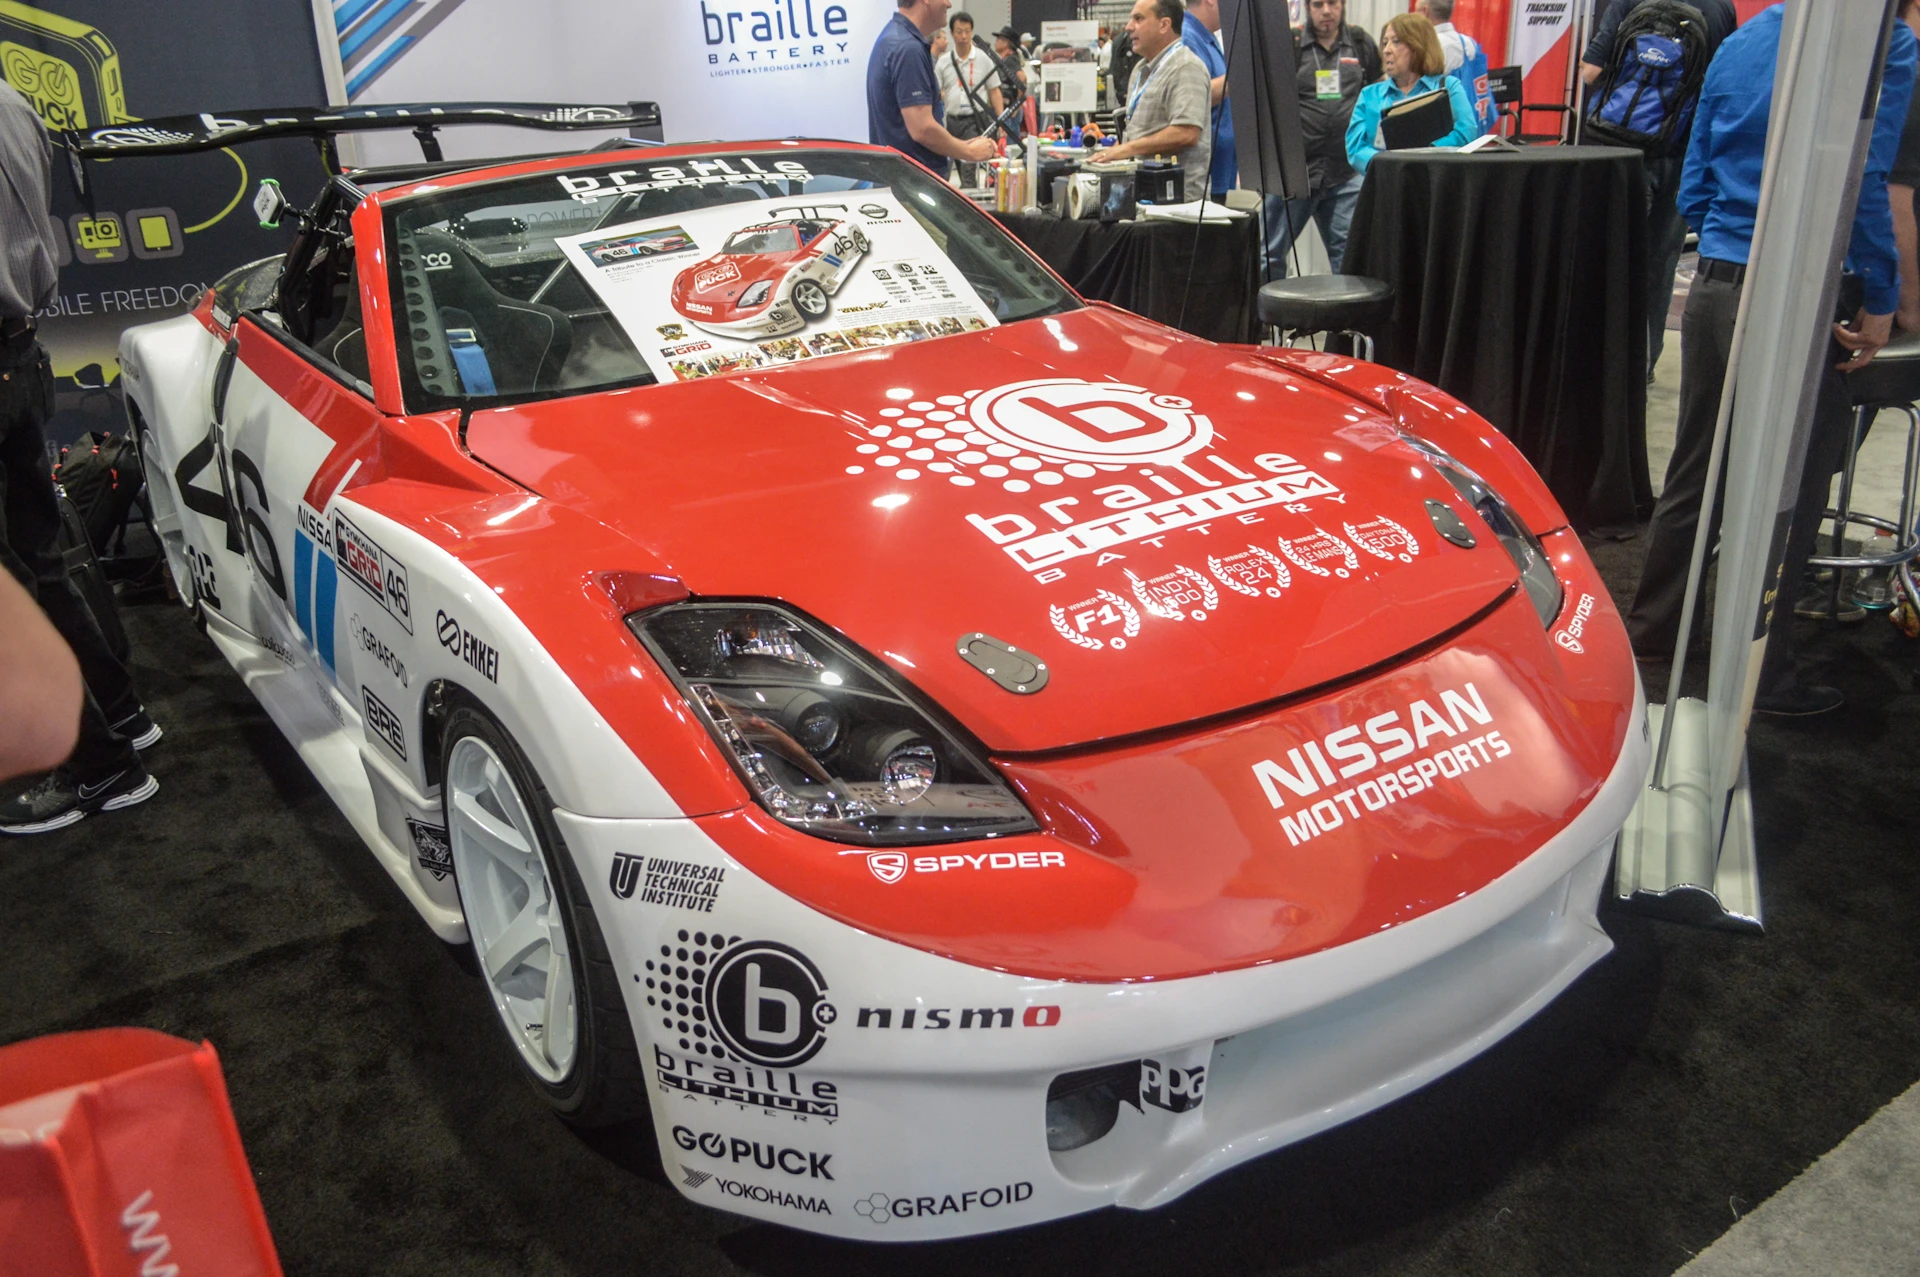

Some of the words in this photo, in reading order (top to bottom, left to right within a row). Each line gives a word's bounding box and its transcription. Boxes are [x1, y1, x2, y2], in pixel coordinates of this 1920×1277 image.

[1525, 2, 1567, 13] TRACKSIDE
[1527, 15, 1563, 26] SUPPORT
[700, 0, 848, 45] braille
[708, 42, 848, 64] BATTERY
[710, 68, 746, 77] LIGHTER
[753, 63, 802, 73] STRONGER
[809, 58, 850, 68] FASTER
[834, 235, 853, 257] 46
[965, 452, 1307, 545] braille
[297, 504, 334, 554] NISSA
[1009, 474, 1333, 566] LITHIUM
[1356, 520, 1380, 529] WINNER
[345, 526, 379, 560] GYMKHANA
[1033, 493, 1347, 585] BATTERY
[1293, 534, 1318, 544] WINNER
[1359, 528, 1395, 539] DAYTONA
[1369, 533, 1405, 549] 500
[1222, 551, 1250, 563] WINNER
[1295, 546, 1309, 554] 24
[1310, 540, 1332, 552] HRS
[1299, 552, 1316, 563] LE
[1314, 545, 1346, 560] MANS
[1148, 572, 1177, 585] WINNER
[1224, 557, 1268, 575] ROLEX
[1239, 567, 1273, 585] 24
[387, 568, 408, 617] 46
[1148, 577, 1192, 601] INDY
[1162, 589, 1202, 610] 500
[1068, 597, 1099, 612] WINNER
[1568, 593, 1595, 638] SPYDER
[1075, 604, 1122, 634] F1
[363, 626, 408, 689] GRAFOID
[463, 629, 499, 685] ENKEI
[366, 693, 404, 753] BRE
[1251, 682, 1494, 810] NISSAN
[1279, 731, 1512, 847] MOTORSPORTS
[647, 857, 726, 882] UNIVERSAL
[913, 851, 1066, 872] SPYDER
[644, 872, 720, 898] TECHNICAL
[640, 887, 716, 913] INSTITUTE
[856, 1005, 1061, 1030] nismo
[654, 1043, 838, 1100] braille
[656, 1070, 839, 1117] LITHIUM
[658, 1083, 840, 1125] BATTERY
[672, 1125, 836, 1181] GOPUCK
[715, 1177, 833, 1216] YOKOHAMA
[891, 1181, 1034, 1218] GRAFOID
